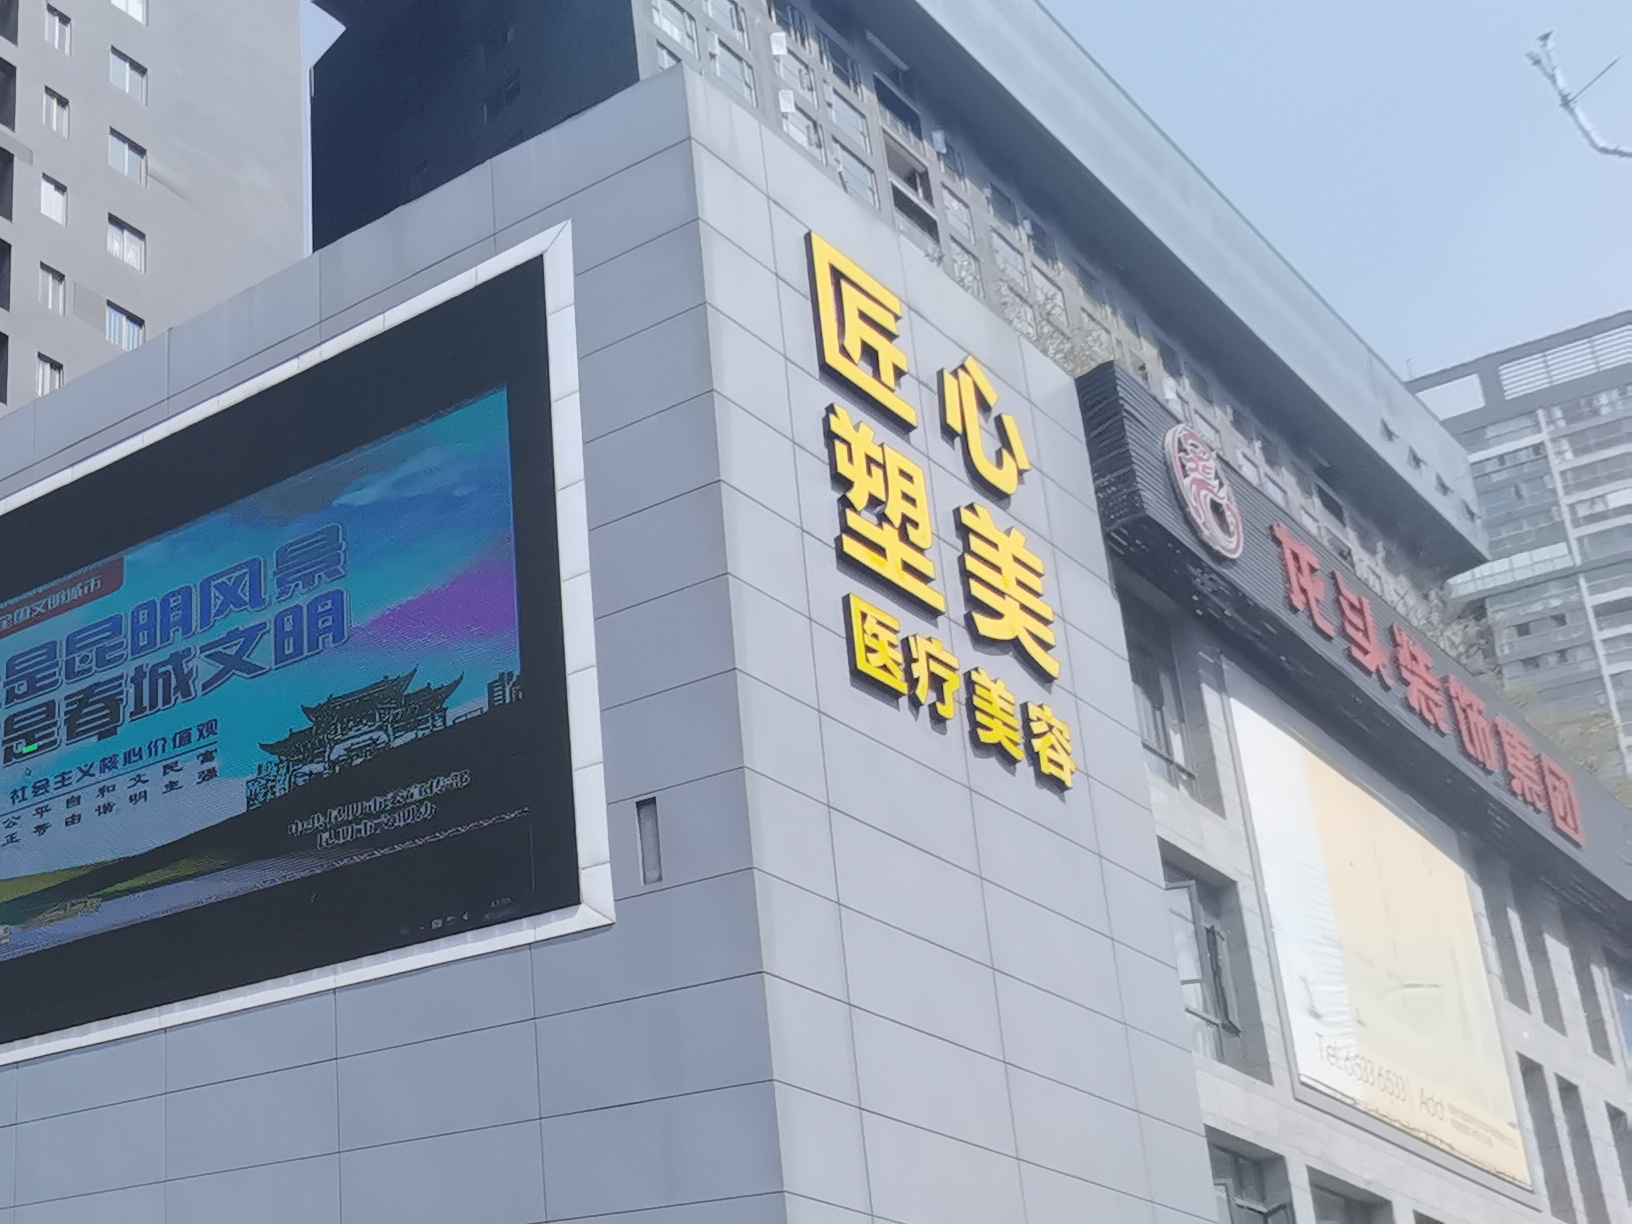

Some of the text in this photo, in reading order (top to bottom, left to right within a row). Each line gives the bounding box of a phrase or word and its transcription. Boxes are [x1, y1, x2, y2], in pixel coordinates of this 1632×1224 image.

[807, 230, 1031, 498] 匠心
[825, 403, 1062, 681] 塑美
[9, 718, 219, 805] 社会主义核心价值观
[846, 593, 1077, 791] 医疗美容
